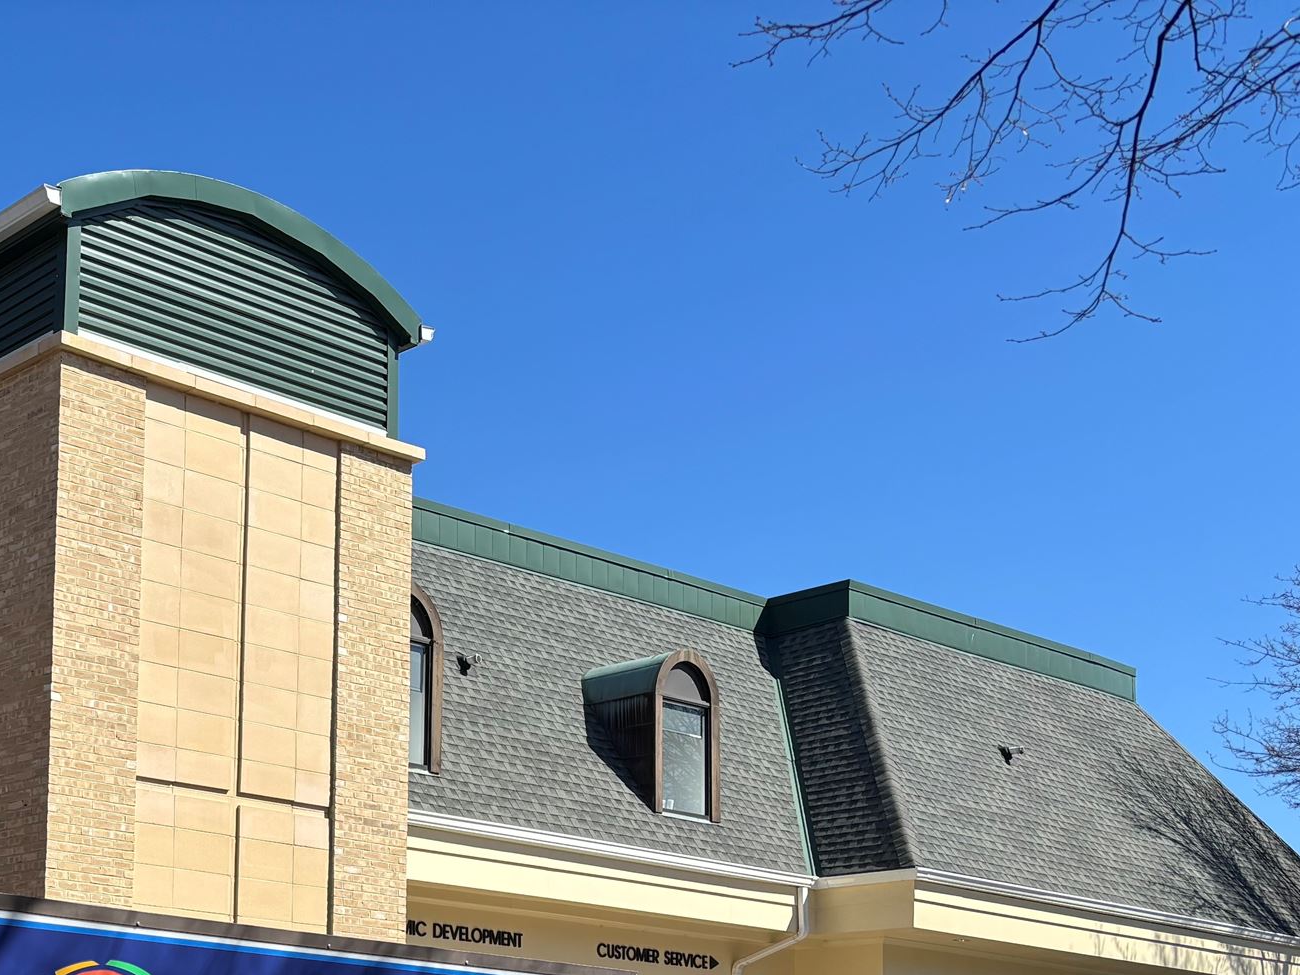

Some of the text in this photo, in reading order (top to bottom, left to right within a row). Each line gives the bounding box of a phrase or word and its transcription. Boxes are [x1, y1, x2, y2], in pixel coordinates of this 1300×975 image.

[432, 922, 524, 949] DEVELOPMENT
[596, 942, 709, 970] CUSTOMER SERVICE
